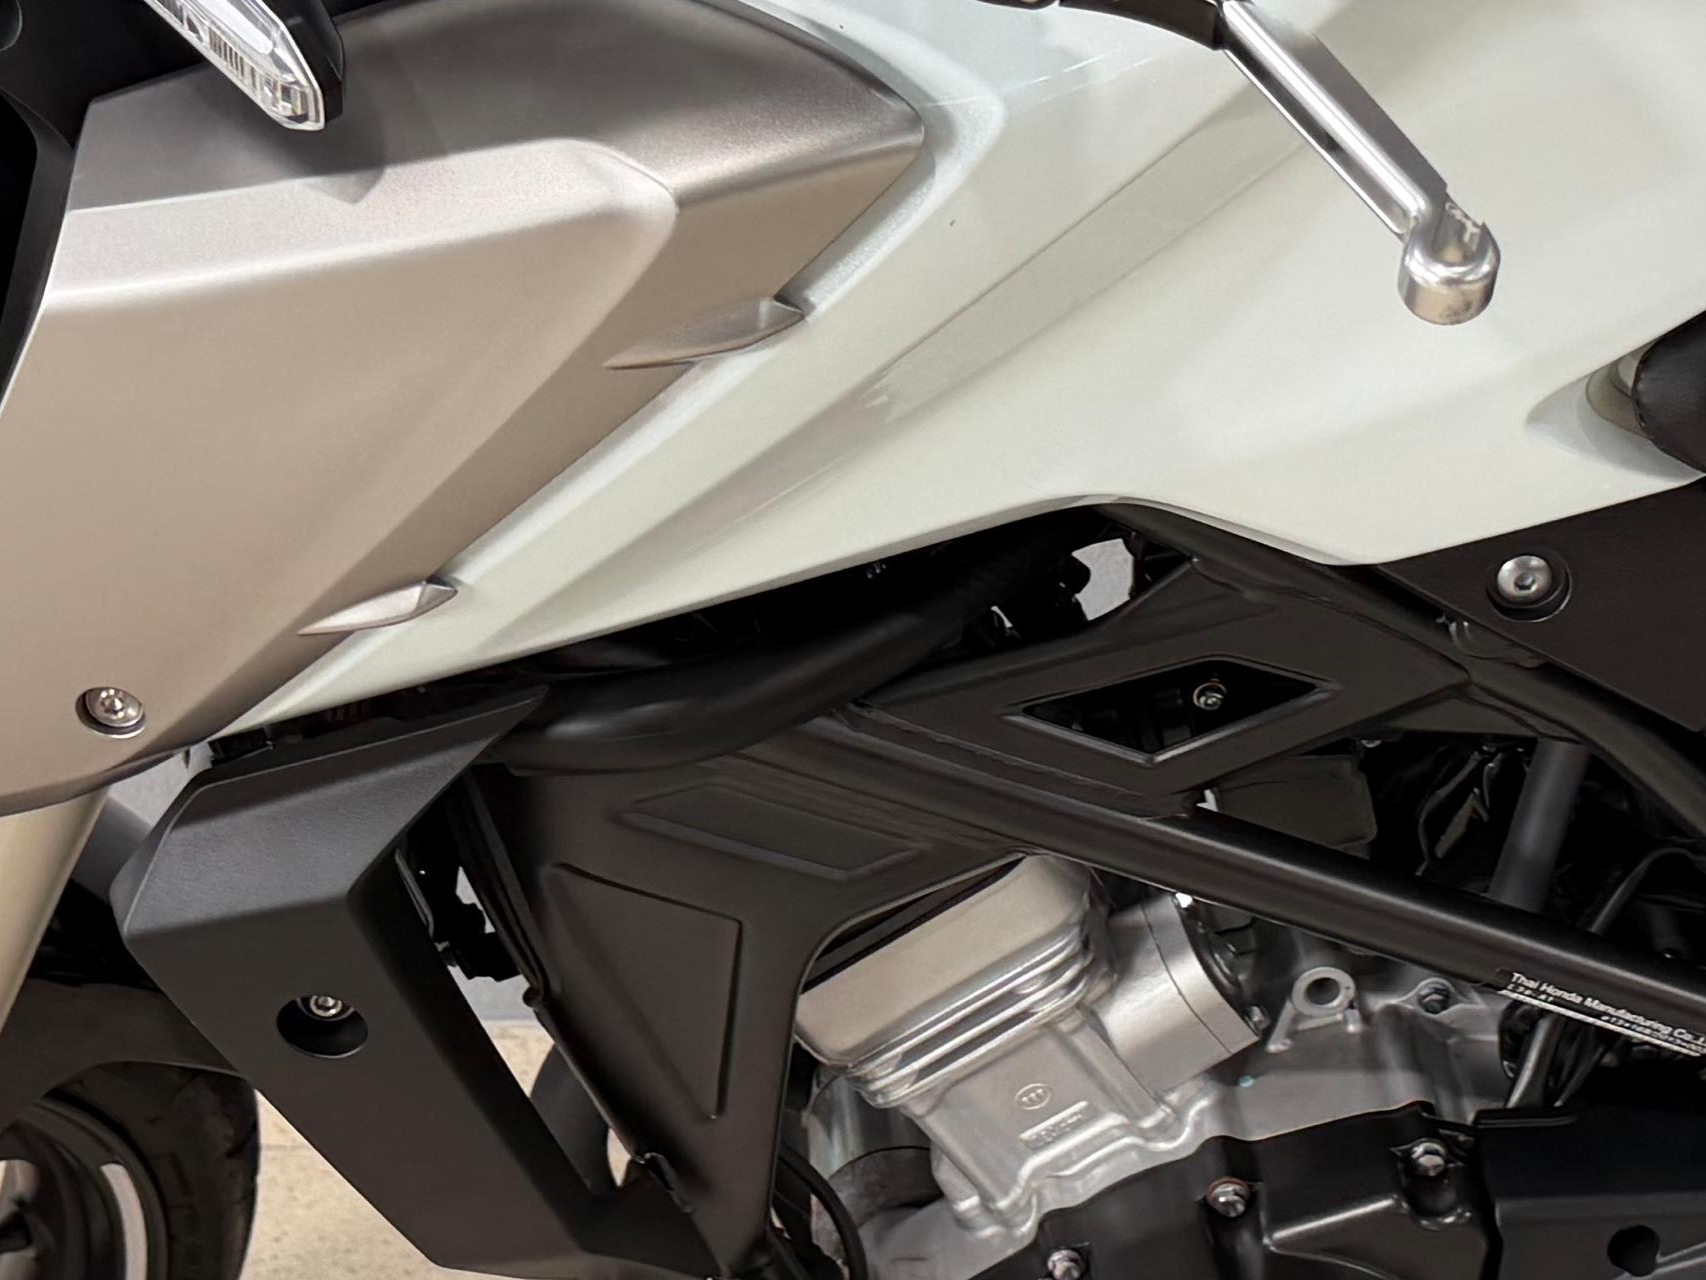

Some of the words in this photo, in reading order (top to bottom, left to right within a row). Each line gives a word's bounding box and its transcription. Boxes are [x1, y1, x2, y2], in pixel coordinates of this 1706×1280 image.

[1510, 972, 1538, 990] Thai
[1540, 981, 1584, 1004] Honda
[1584, 996, 1673, 1036] Manufacturing
